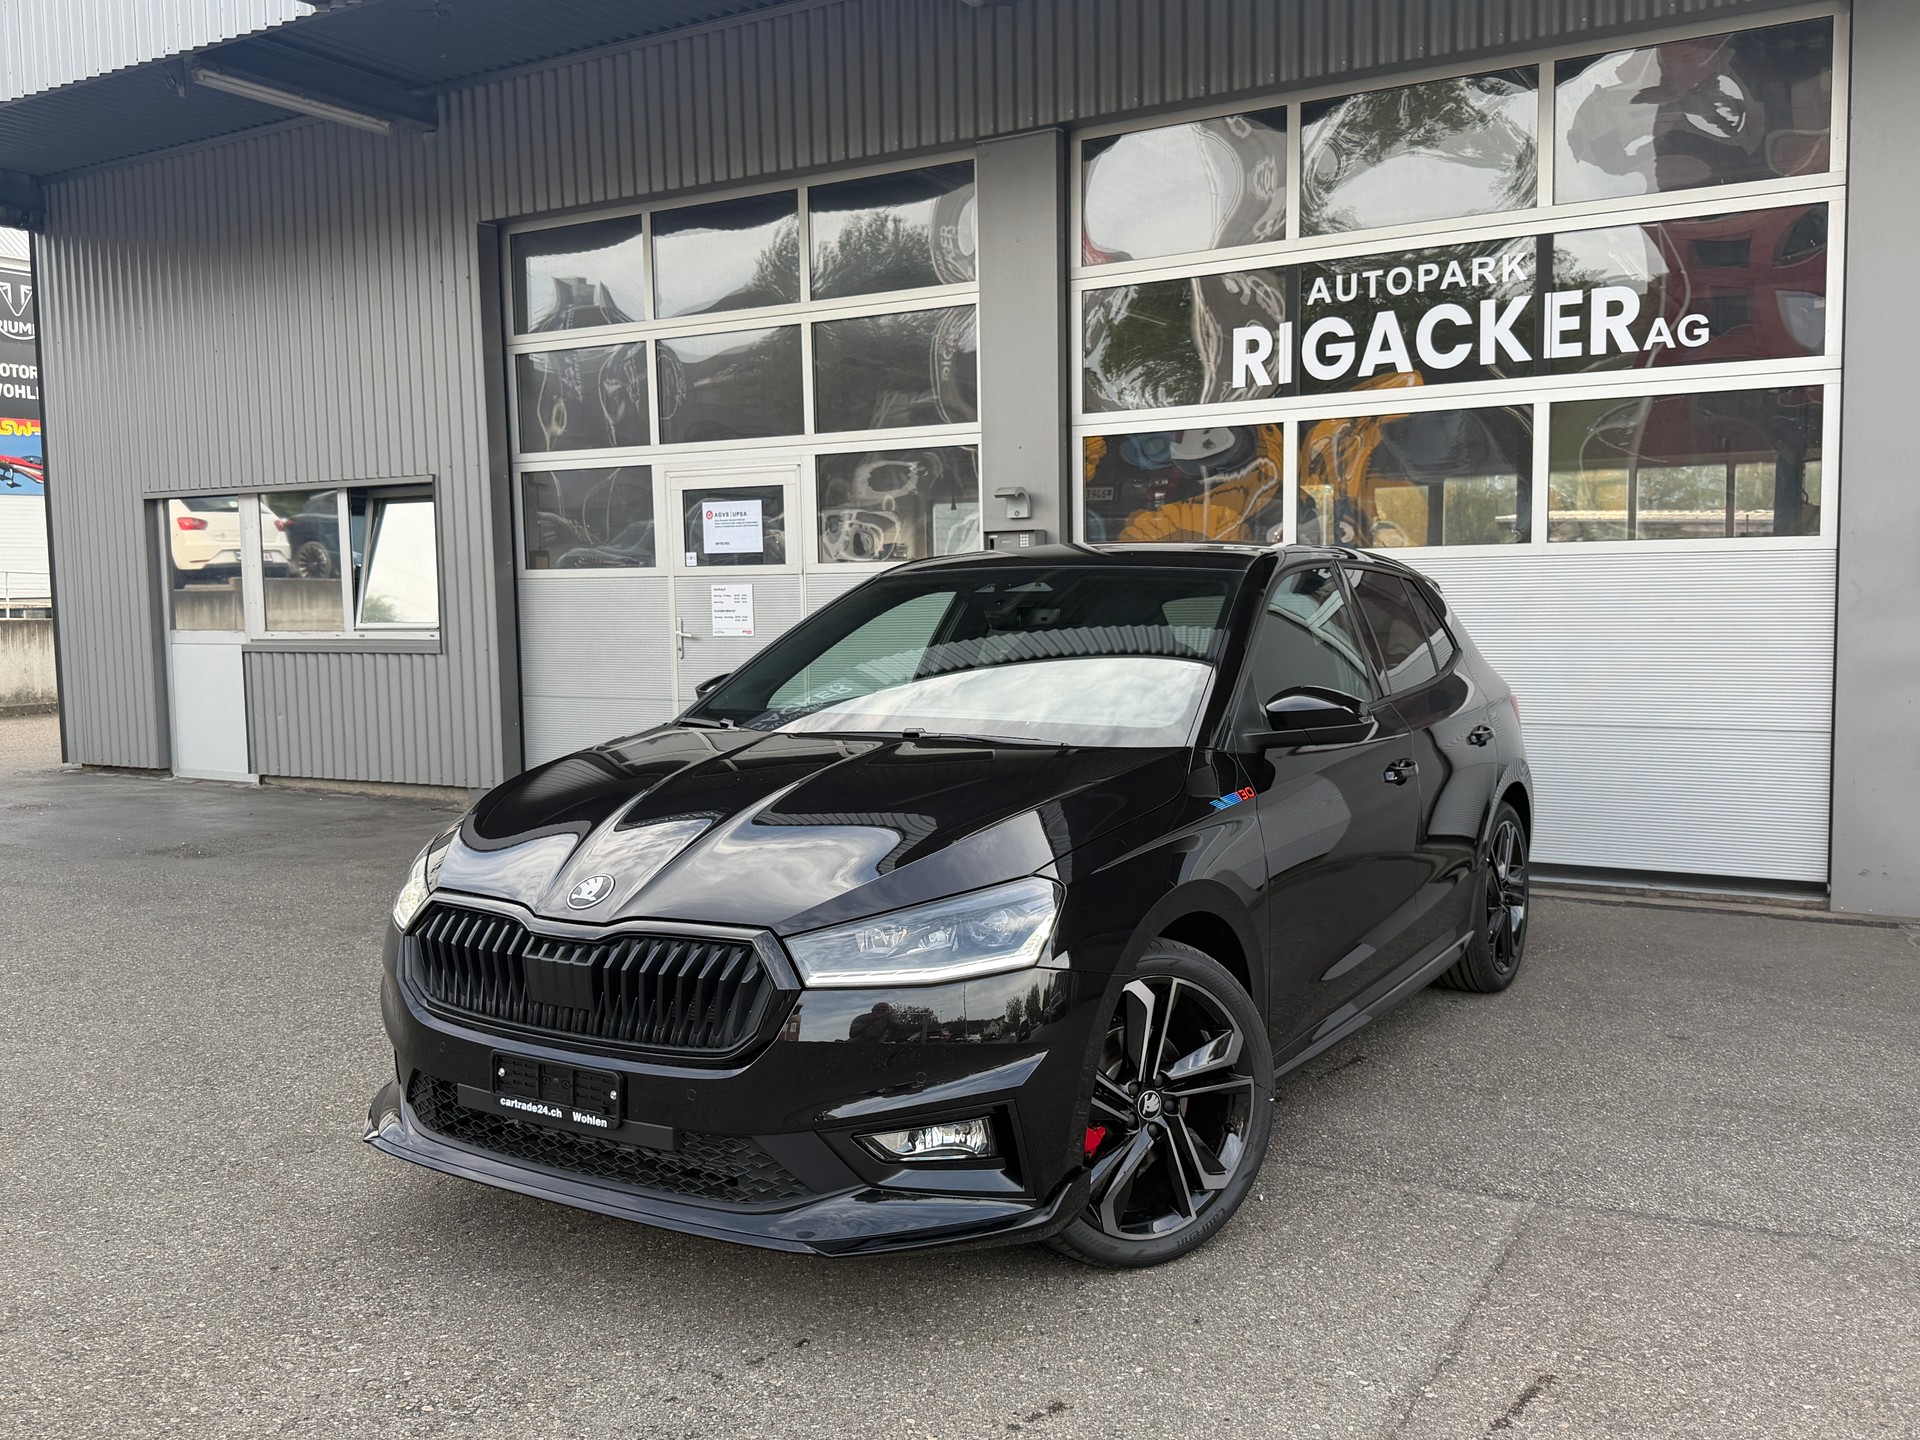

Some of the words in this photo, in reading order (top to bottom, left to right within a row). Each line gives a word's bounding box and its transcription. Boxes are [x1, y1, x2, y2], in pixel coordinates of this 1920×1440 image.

[1306, 252, 1529, 306] AUTOPARK
[0, 319, 35, 336] IUM
[1232, 284, 1643, 389] RIGACKER
[1643, 313, 1710, 350] AG
[500, 1097, 563, 1119] cartrade24.ch
[572, 1111, 608, 1128] Wohlen
